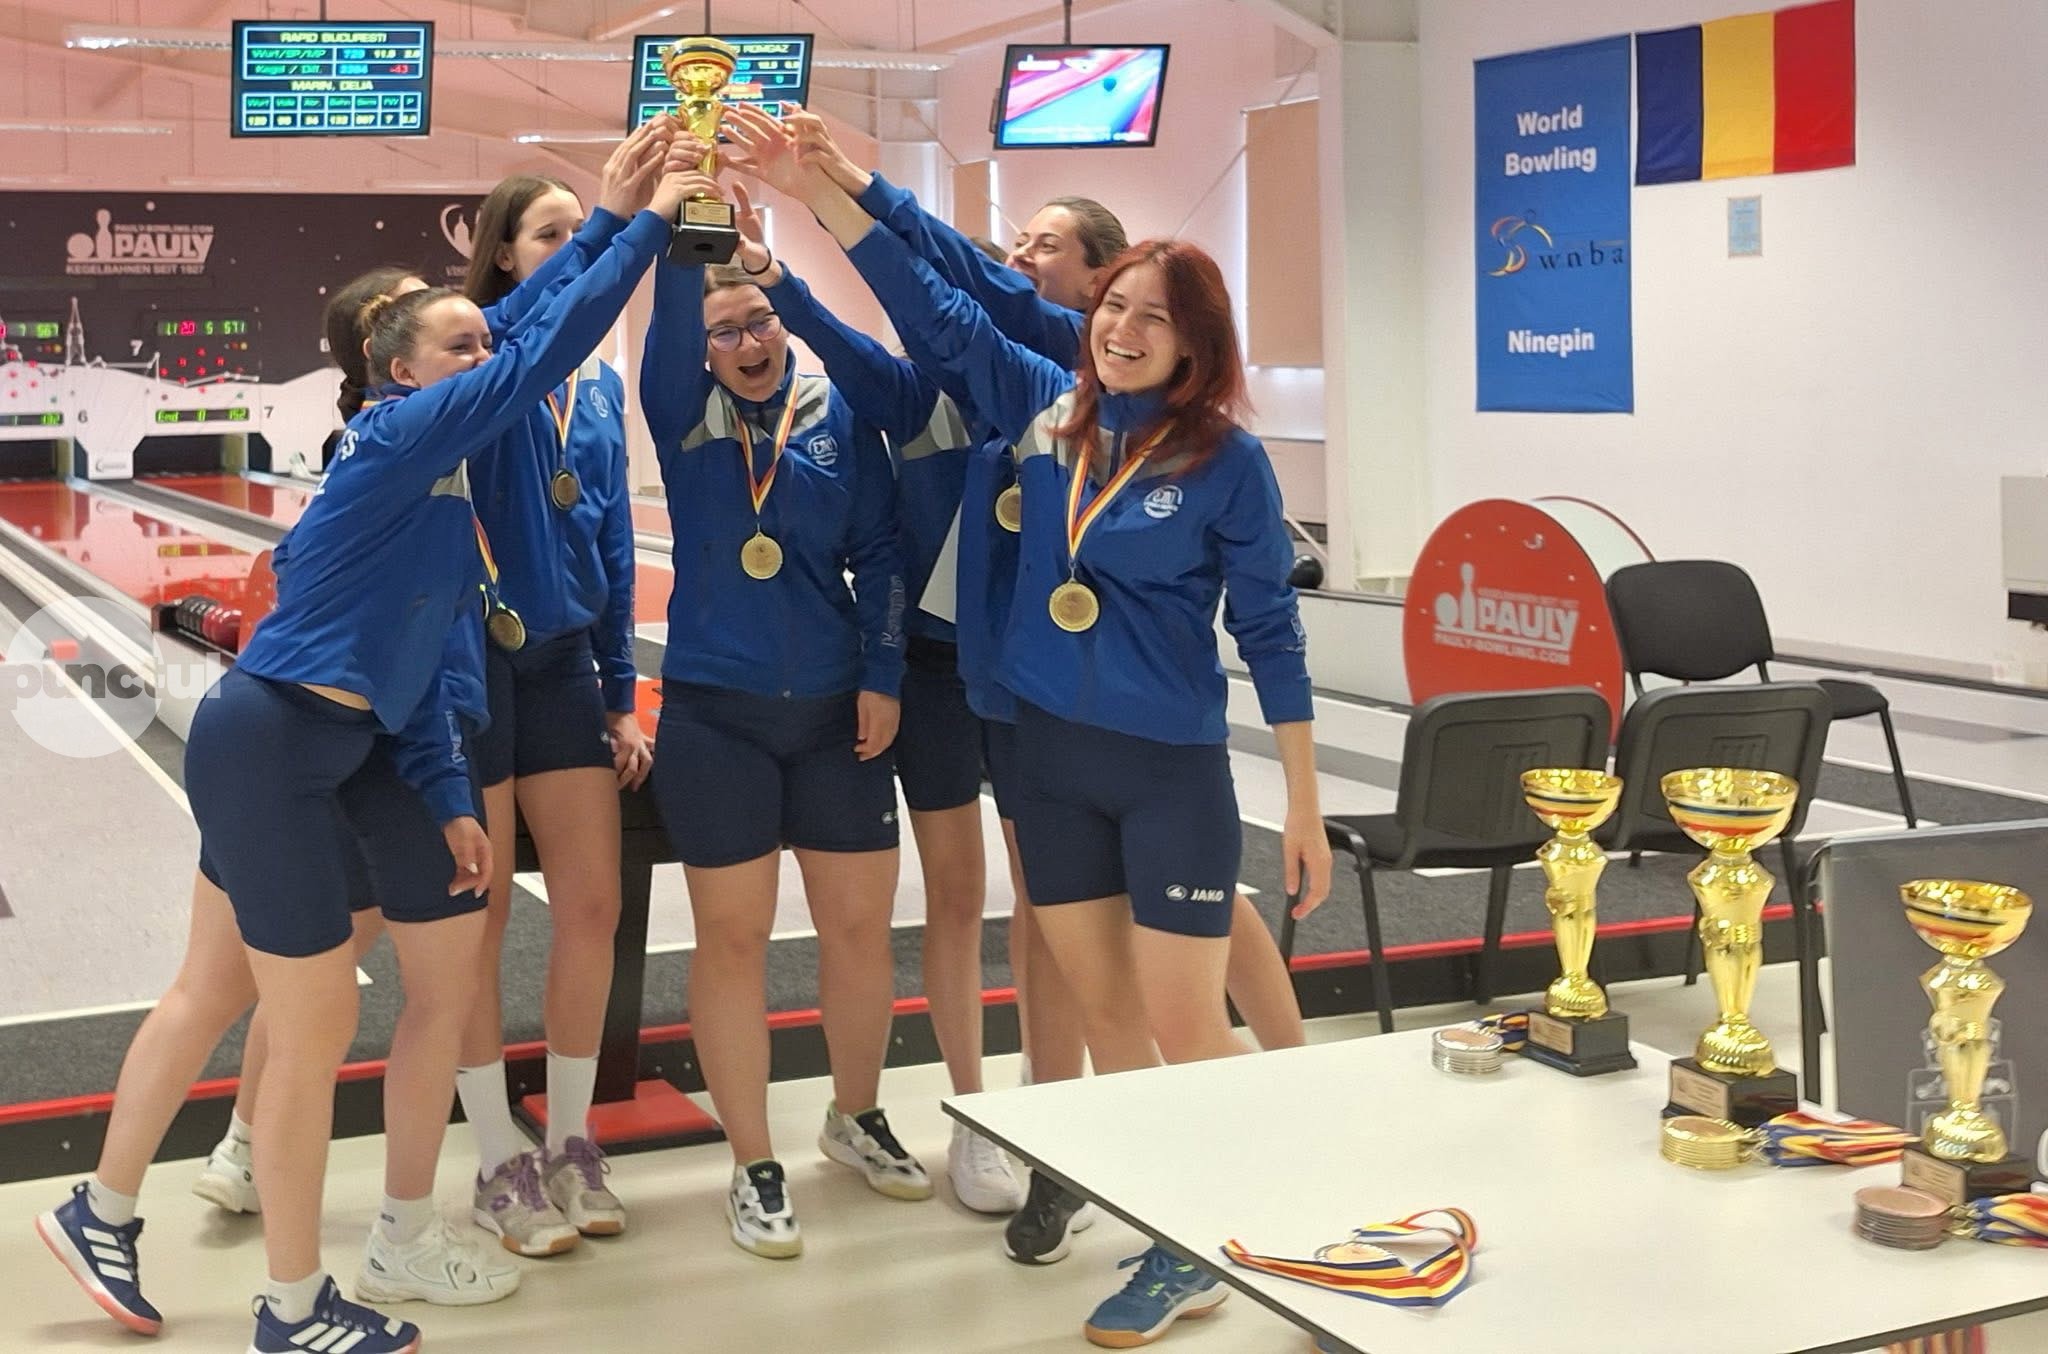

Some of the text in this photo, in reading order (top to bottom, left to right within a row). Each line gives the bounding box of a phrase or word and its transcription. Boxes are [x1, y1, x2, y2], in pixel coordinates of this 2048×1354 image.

[280, 33, 318, 43] RAPID
[1517, 105, 1583, 136] World
[1504, 147, 1597, 176] Bowling
[114, 233, 214, 262] PAULY
[1539, 240, 1625, 270] wnba
[130, 340, 144, 356] 7
[1508, 328, 1595, 358] Ninepin
[78, 410, 88, 423] 6
[264, 406, 274, 419] 7
[1477, 597, 1579, 650] PAULY
[1190, 888, 1225, 902] JAKO
